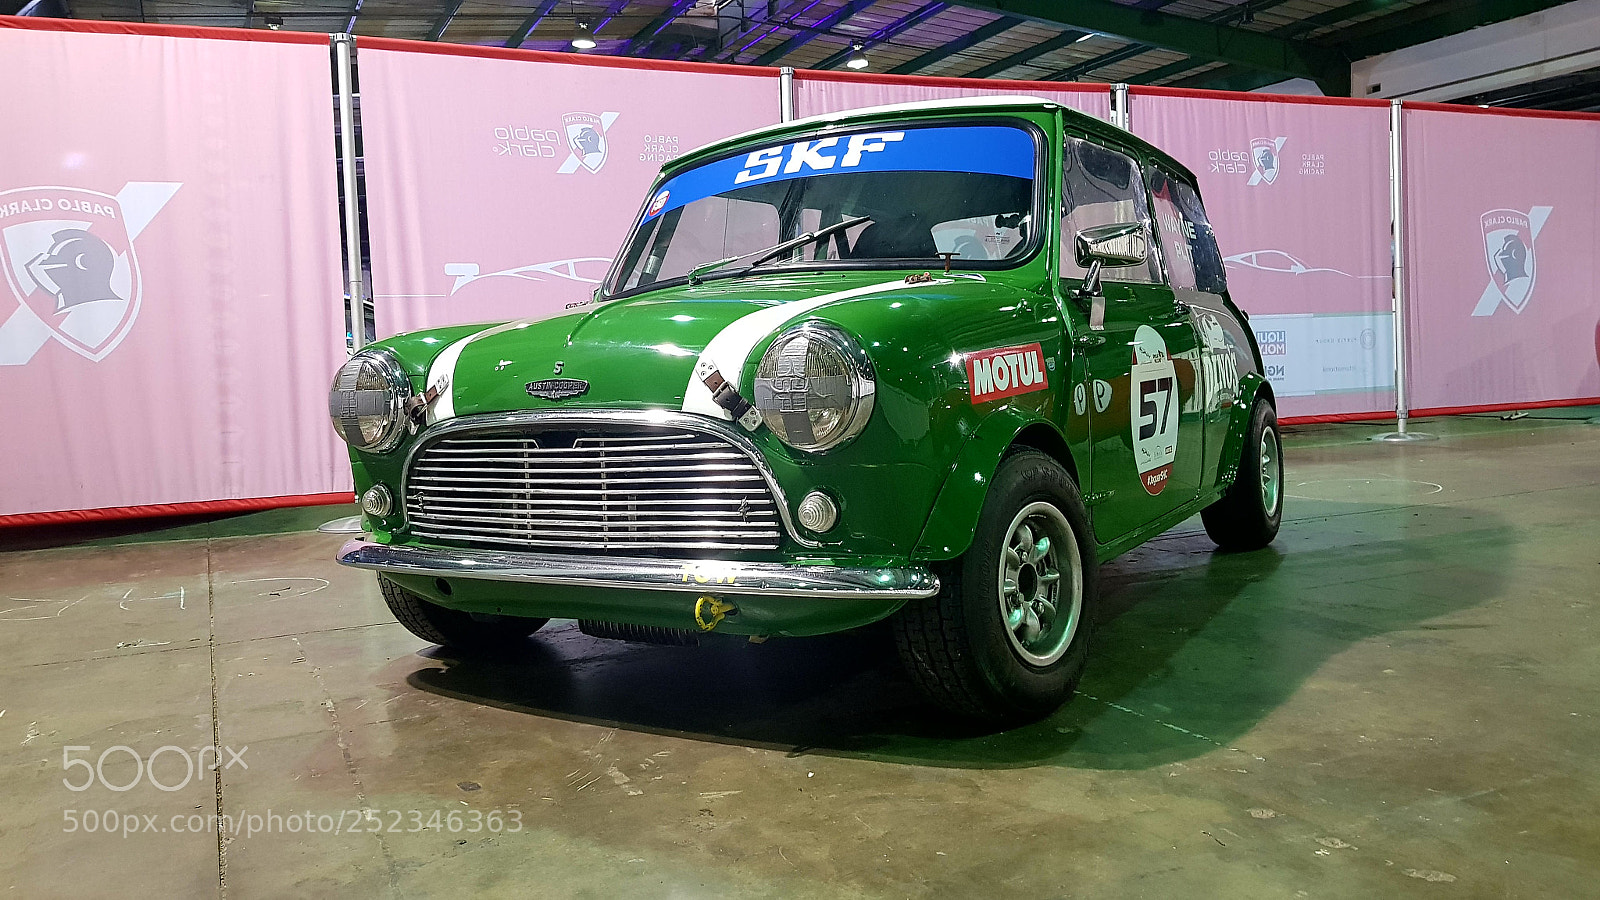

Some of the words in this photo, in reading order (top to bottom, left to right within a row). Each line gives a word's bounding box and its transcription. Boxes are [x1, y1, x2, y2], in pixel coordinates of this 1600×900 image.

[734, 132, 905, 184] SKF
[973, 351, 1044, 396] MOTUL
[1139, 377, 1173, 441] 57
